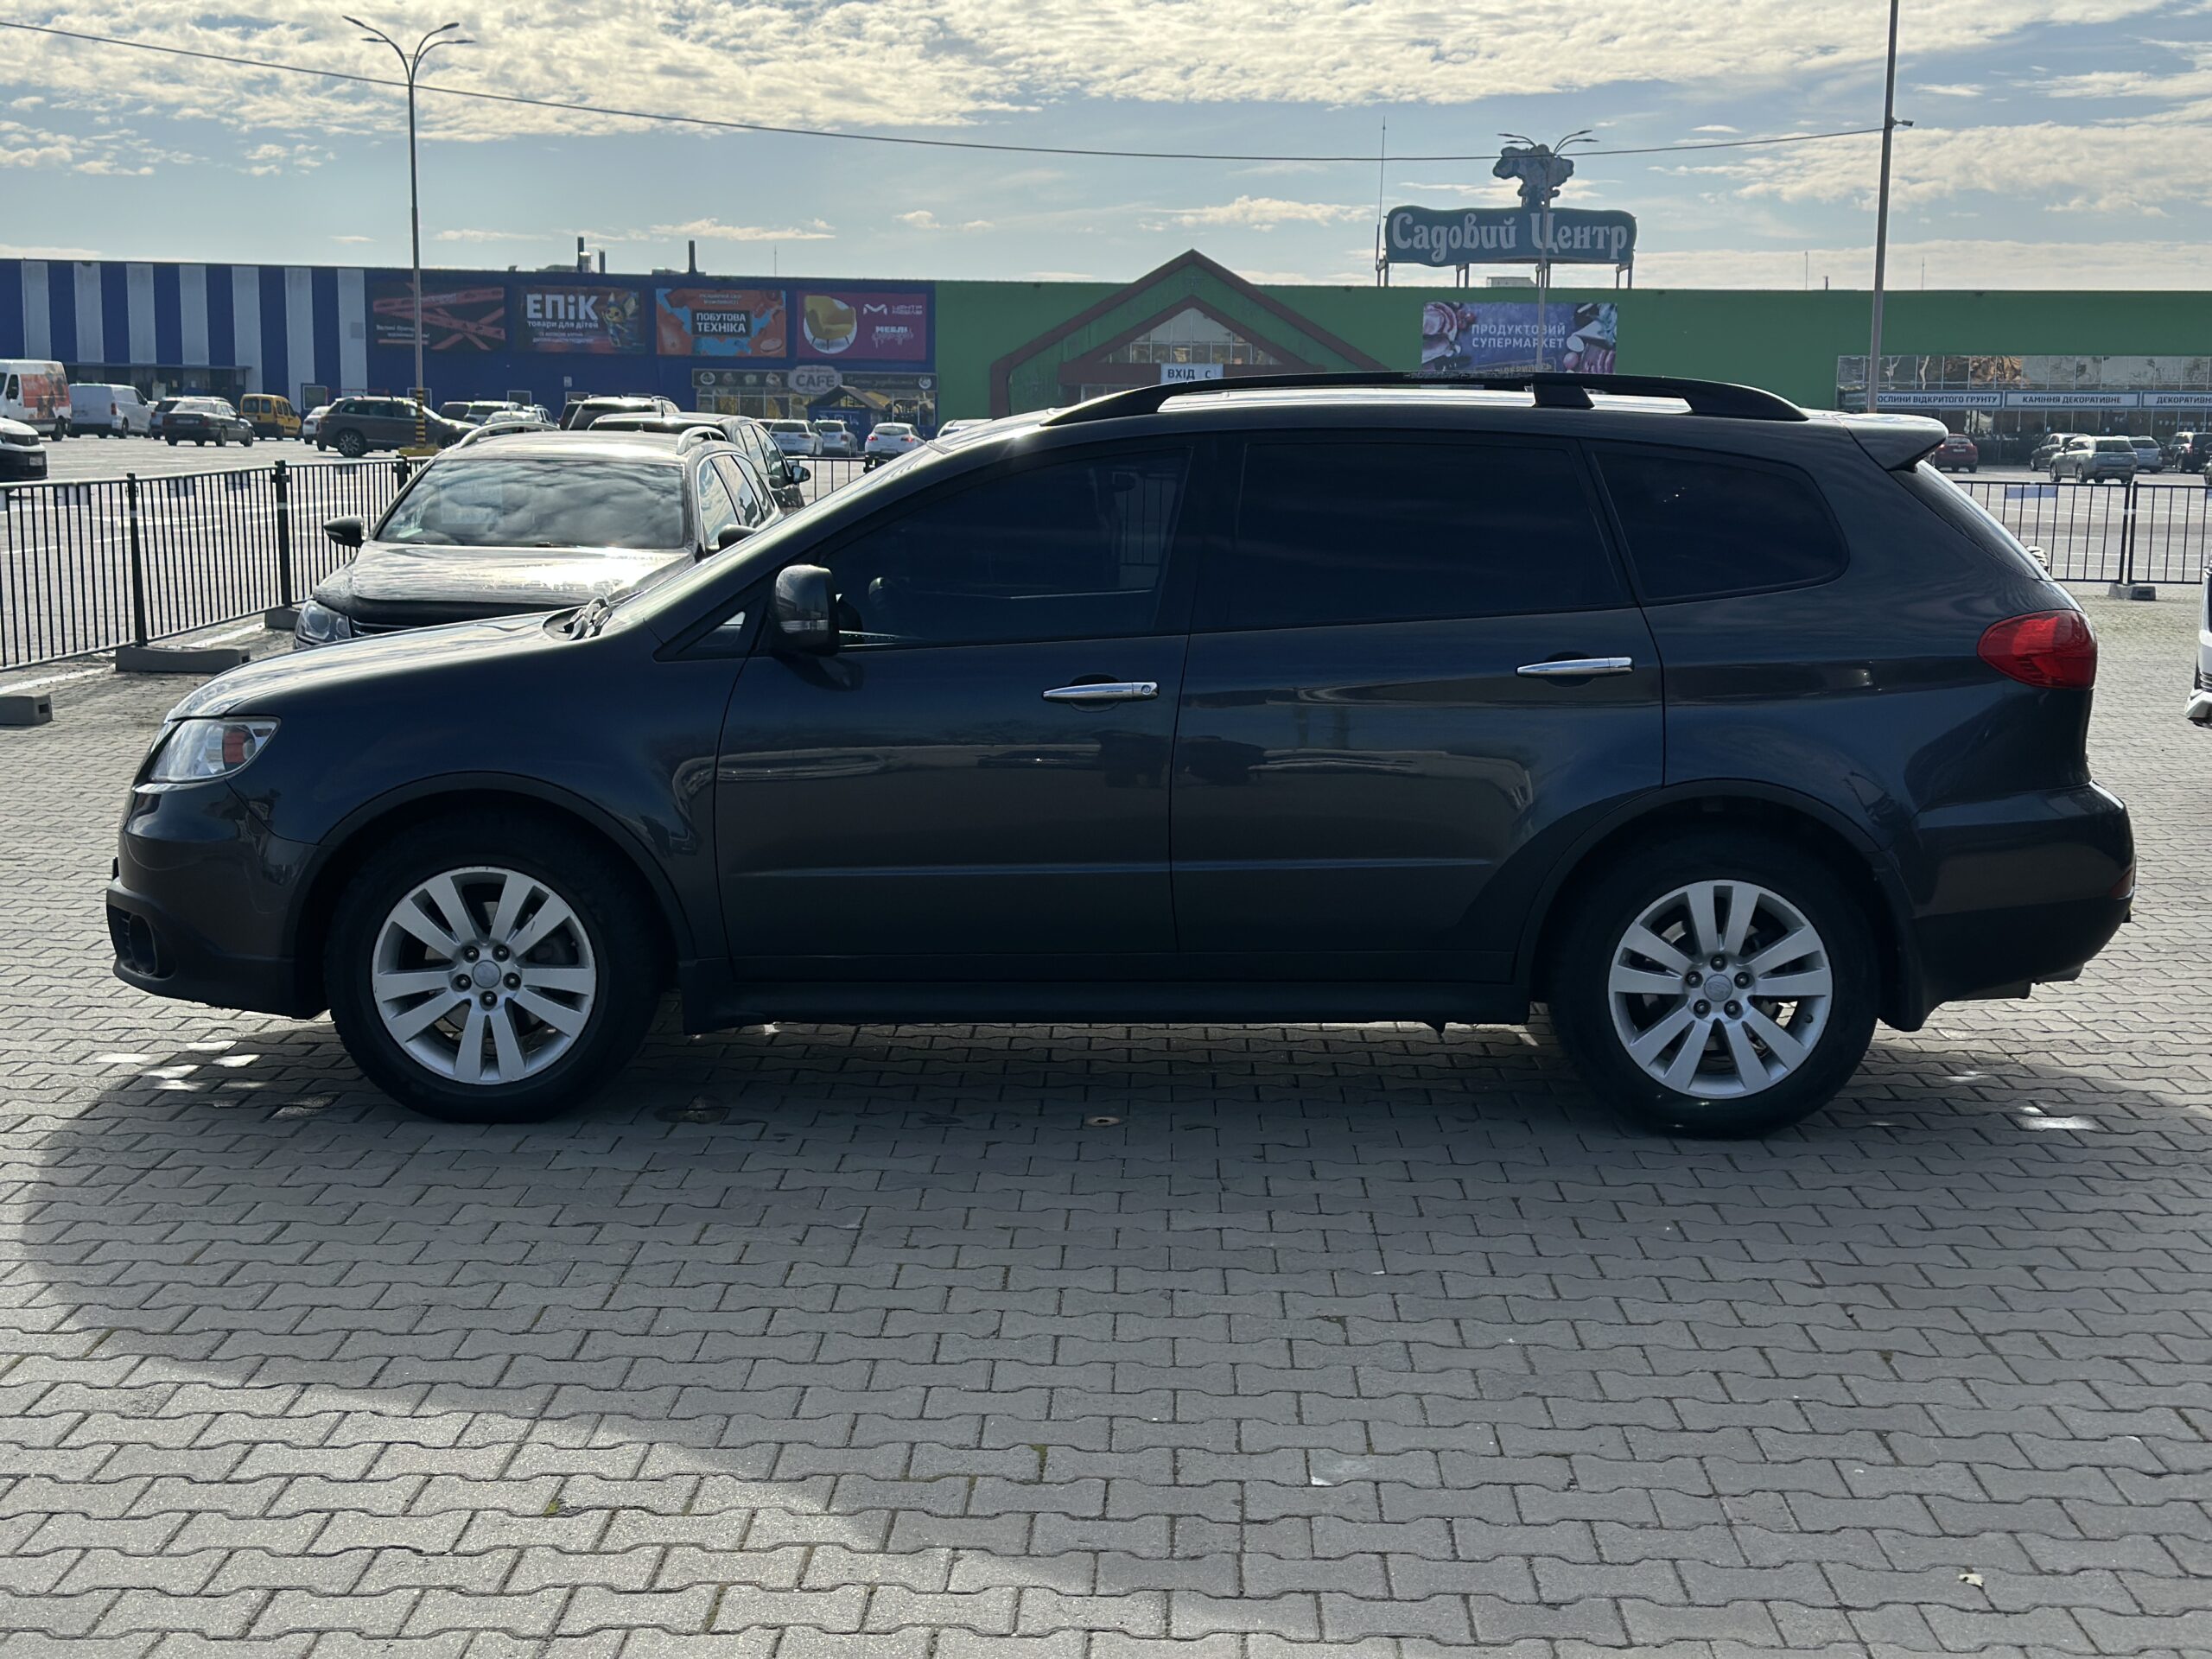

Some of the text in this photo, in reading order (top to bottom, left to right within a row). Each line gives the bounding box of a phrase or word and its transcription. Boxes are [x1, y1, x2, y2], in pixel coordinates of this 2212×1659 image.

[1392, 213, 1628, 263] Садовий Центр
[696, 312, 747, 322] ПОБУТОВА
[558, 321, 575, 329] для
[575, 320, 599, 328] дітей
[696, 322, 747, 333] ТЕХНІКА
[1471, 337, 1565, 348] СУПЕРМАРКЕТ
[1167, 369, 1195, 380] ВХІД
[796, 373, 836, 388] CAFE
[1878, 395, 1911, 404] ОСЛИНИ
[1912, 395, 1964, 404] ВІДКРИТОГО
[2022, 395, 2121, 404] КАМІННЯ ДЕКОРАТИВНЕ
[2156, 396, 2212, 404] ДЕКОРАТИВН
